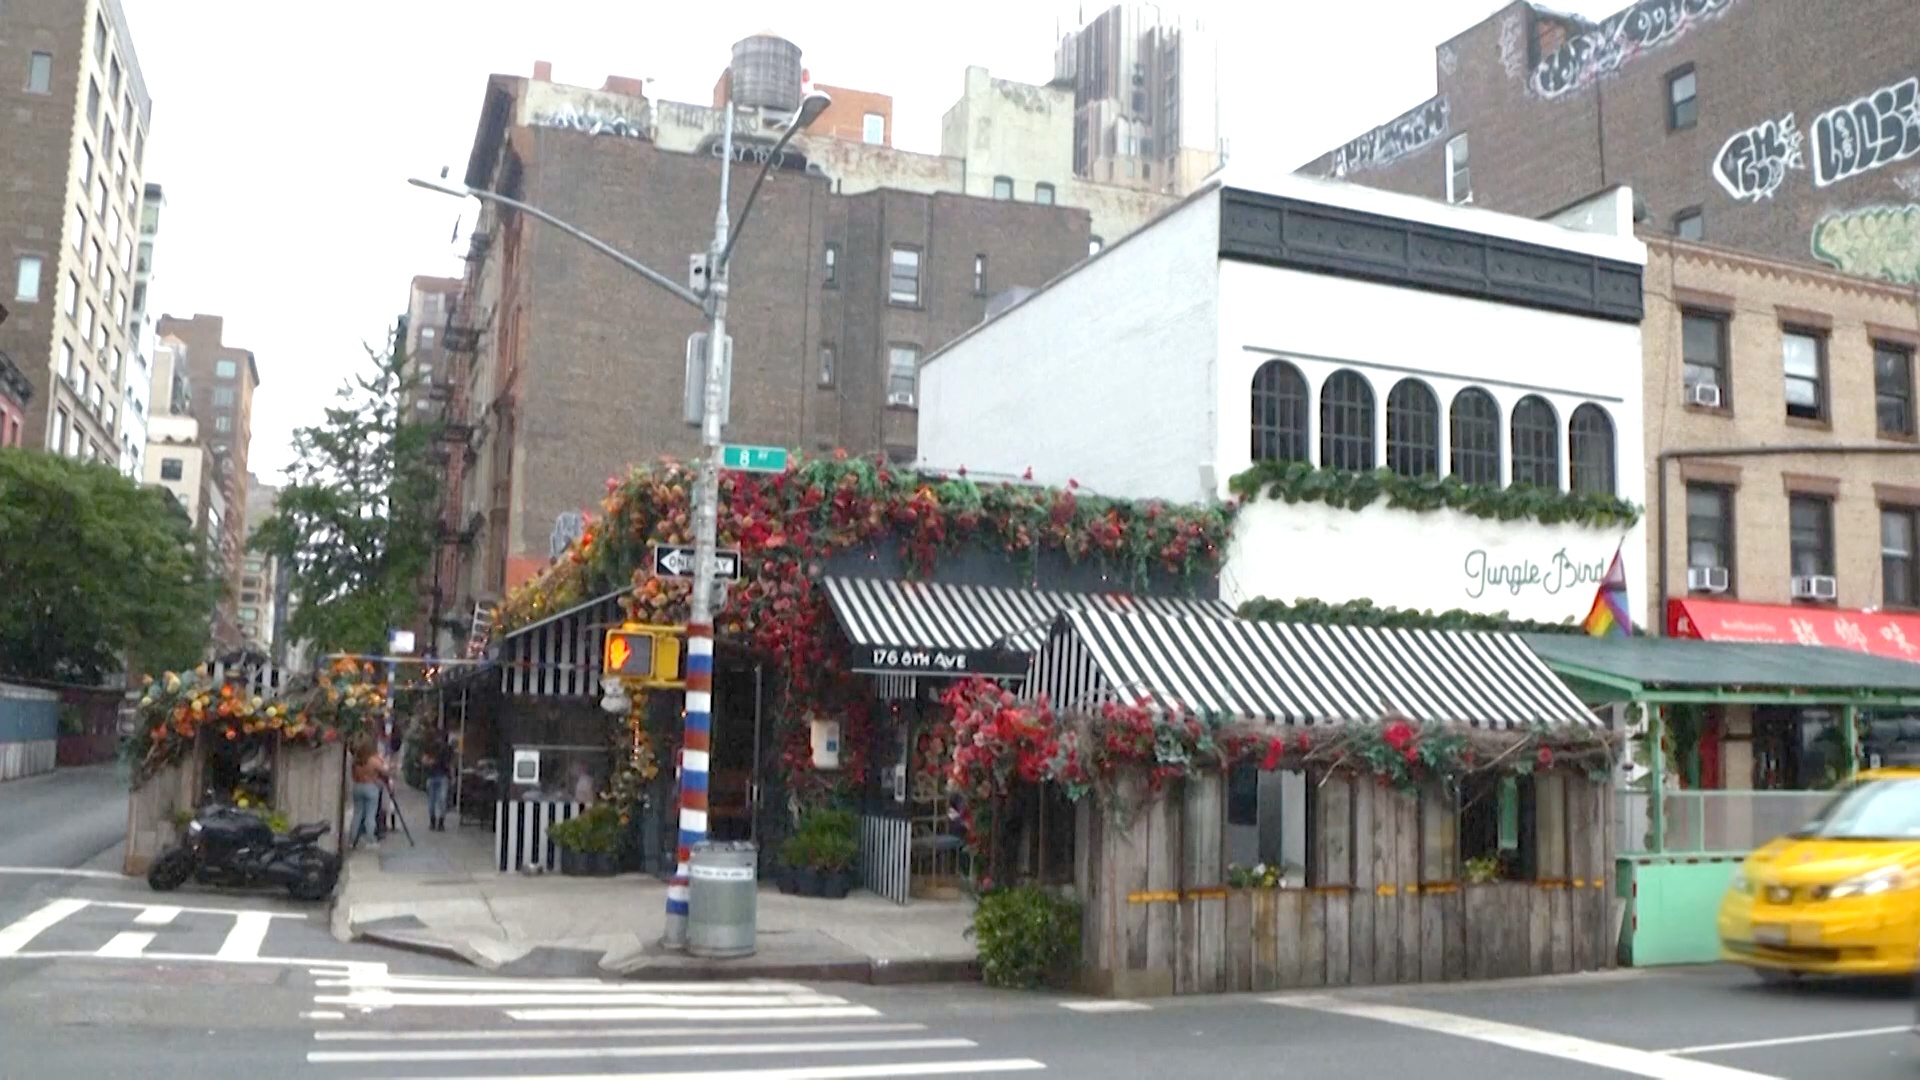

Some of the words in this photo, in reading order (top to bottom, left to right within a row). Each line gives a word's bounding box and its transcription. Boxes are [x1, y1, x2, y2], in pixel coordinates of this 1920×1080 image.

[739, 449, 750, 468] 8
[1464, 549, 1541, 599] Jungle
[1543, 547, 1605, 595] Bird
[873, 648, 898, 667] 176
[934, 651, 966, 669] AVE
